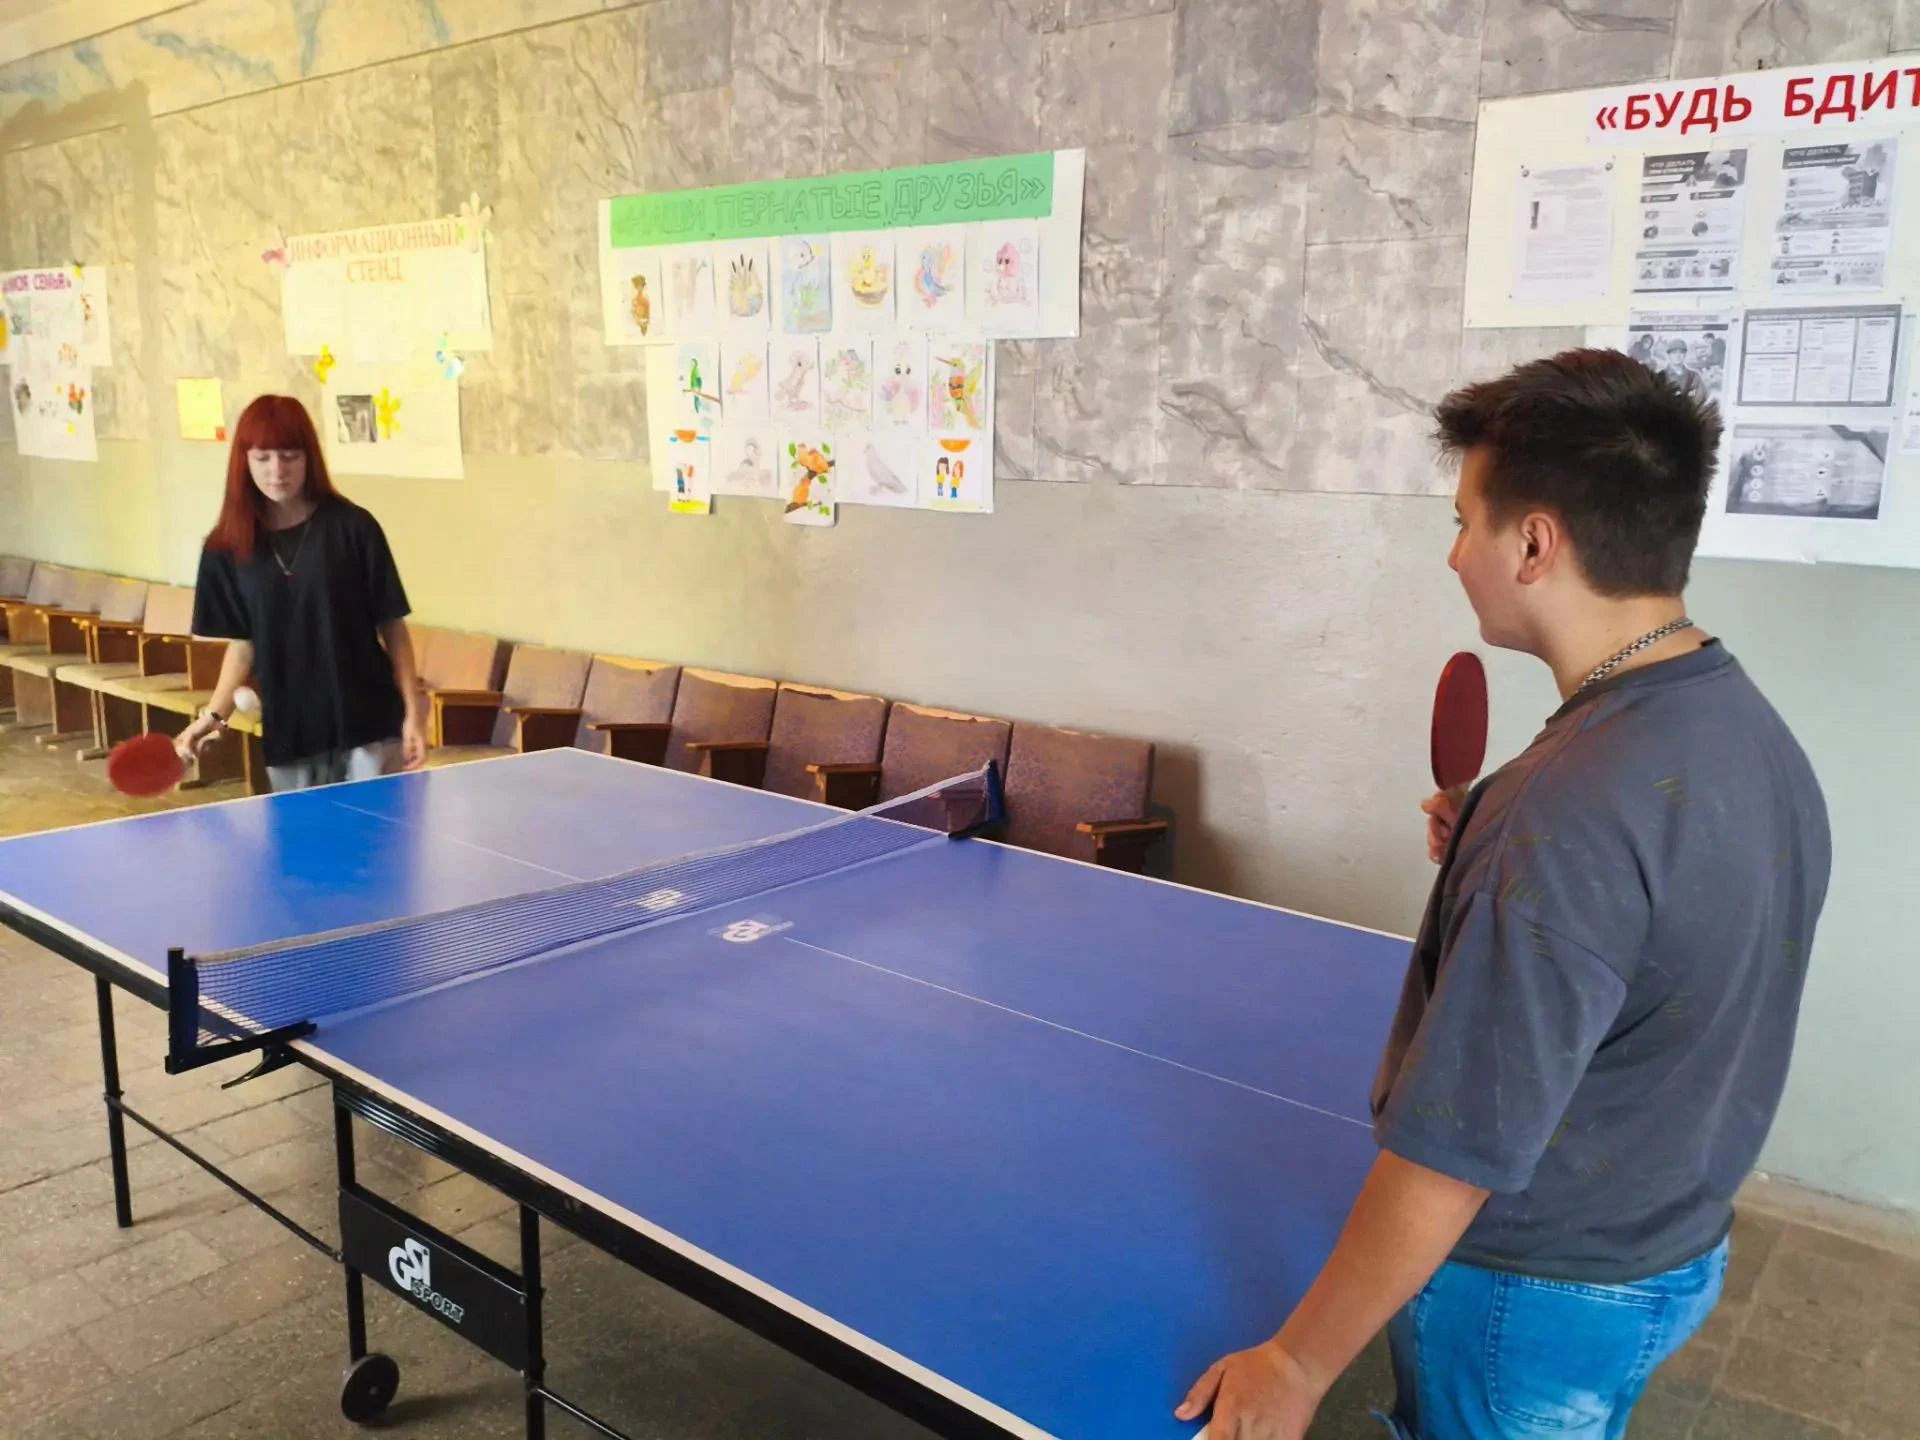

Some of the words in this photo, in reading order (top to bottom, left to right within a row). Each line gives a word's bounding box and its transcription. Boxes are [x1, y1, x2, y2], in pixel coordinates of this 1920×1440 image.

[1596, 84, 1752, 135] «БУДЬ
[714, 180, 881, 230] ПЕРНАТЫЕ
[892, 168, 1046, 219] ДРУЗЬЯ»
[346, 256, 403, 284] СТЕНД
[411, 1279, 465, 1324] SPORT
